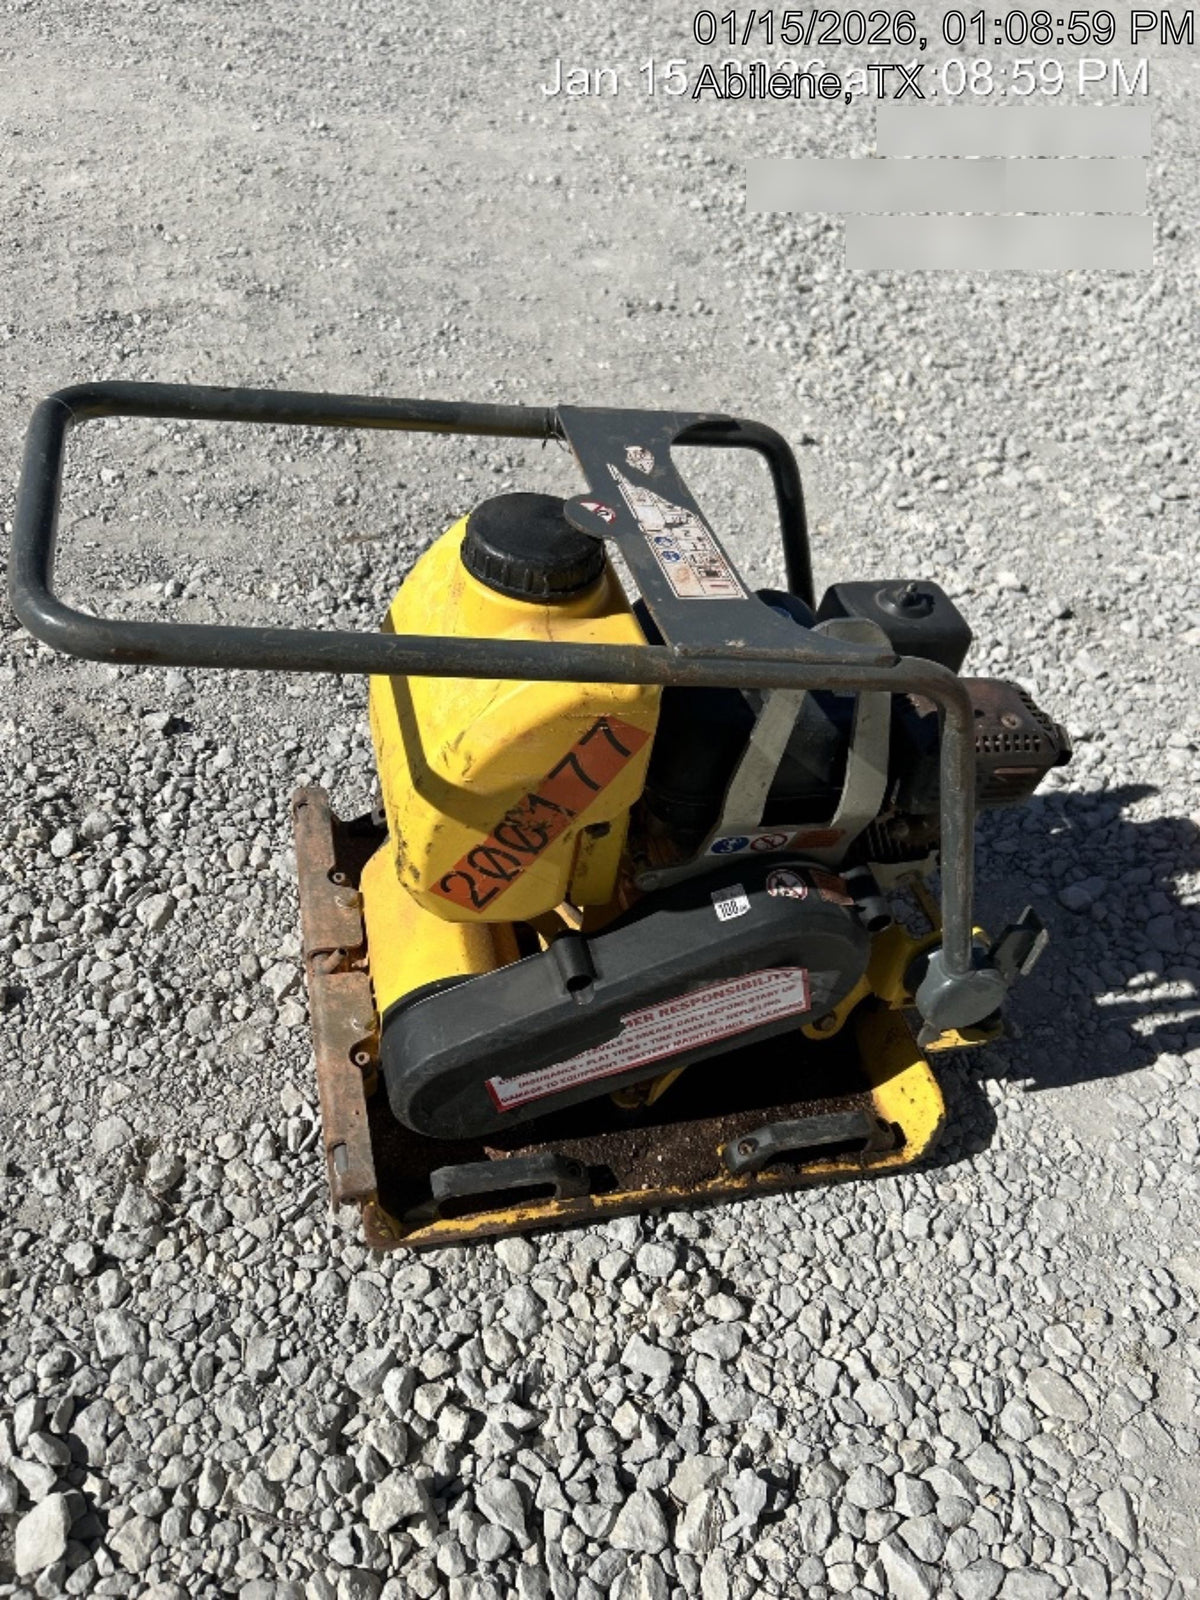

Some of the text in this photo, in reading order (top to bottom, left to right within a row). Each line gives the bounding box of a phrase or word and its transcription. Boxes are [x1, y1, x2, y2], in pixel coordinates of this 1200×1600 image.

[659, 971, 794, 1017] RESPONSIBILITY
[676, 1012, 706, 1027] DAILY
[748, 988, 780, 1004] START
[560, 1060, 618, 1084] EQUIPMENT
